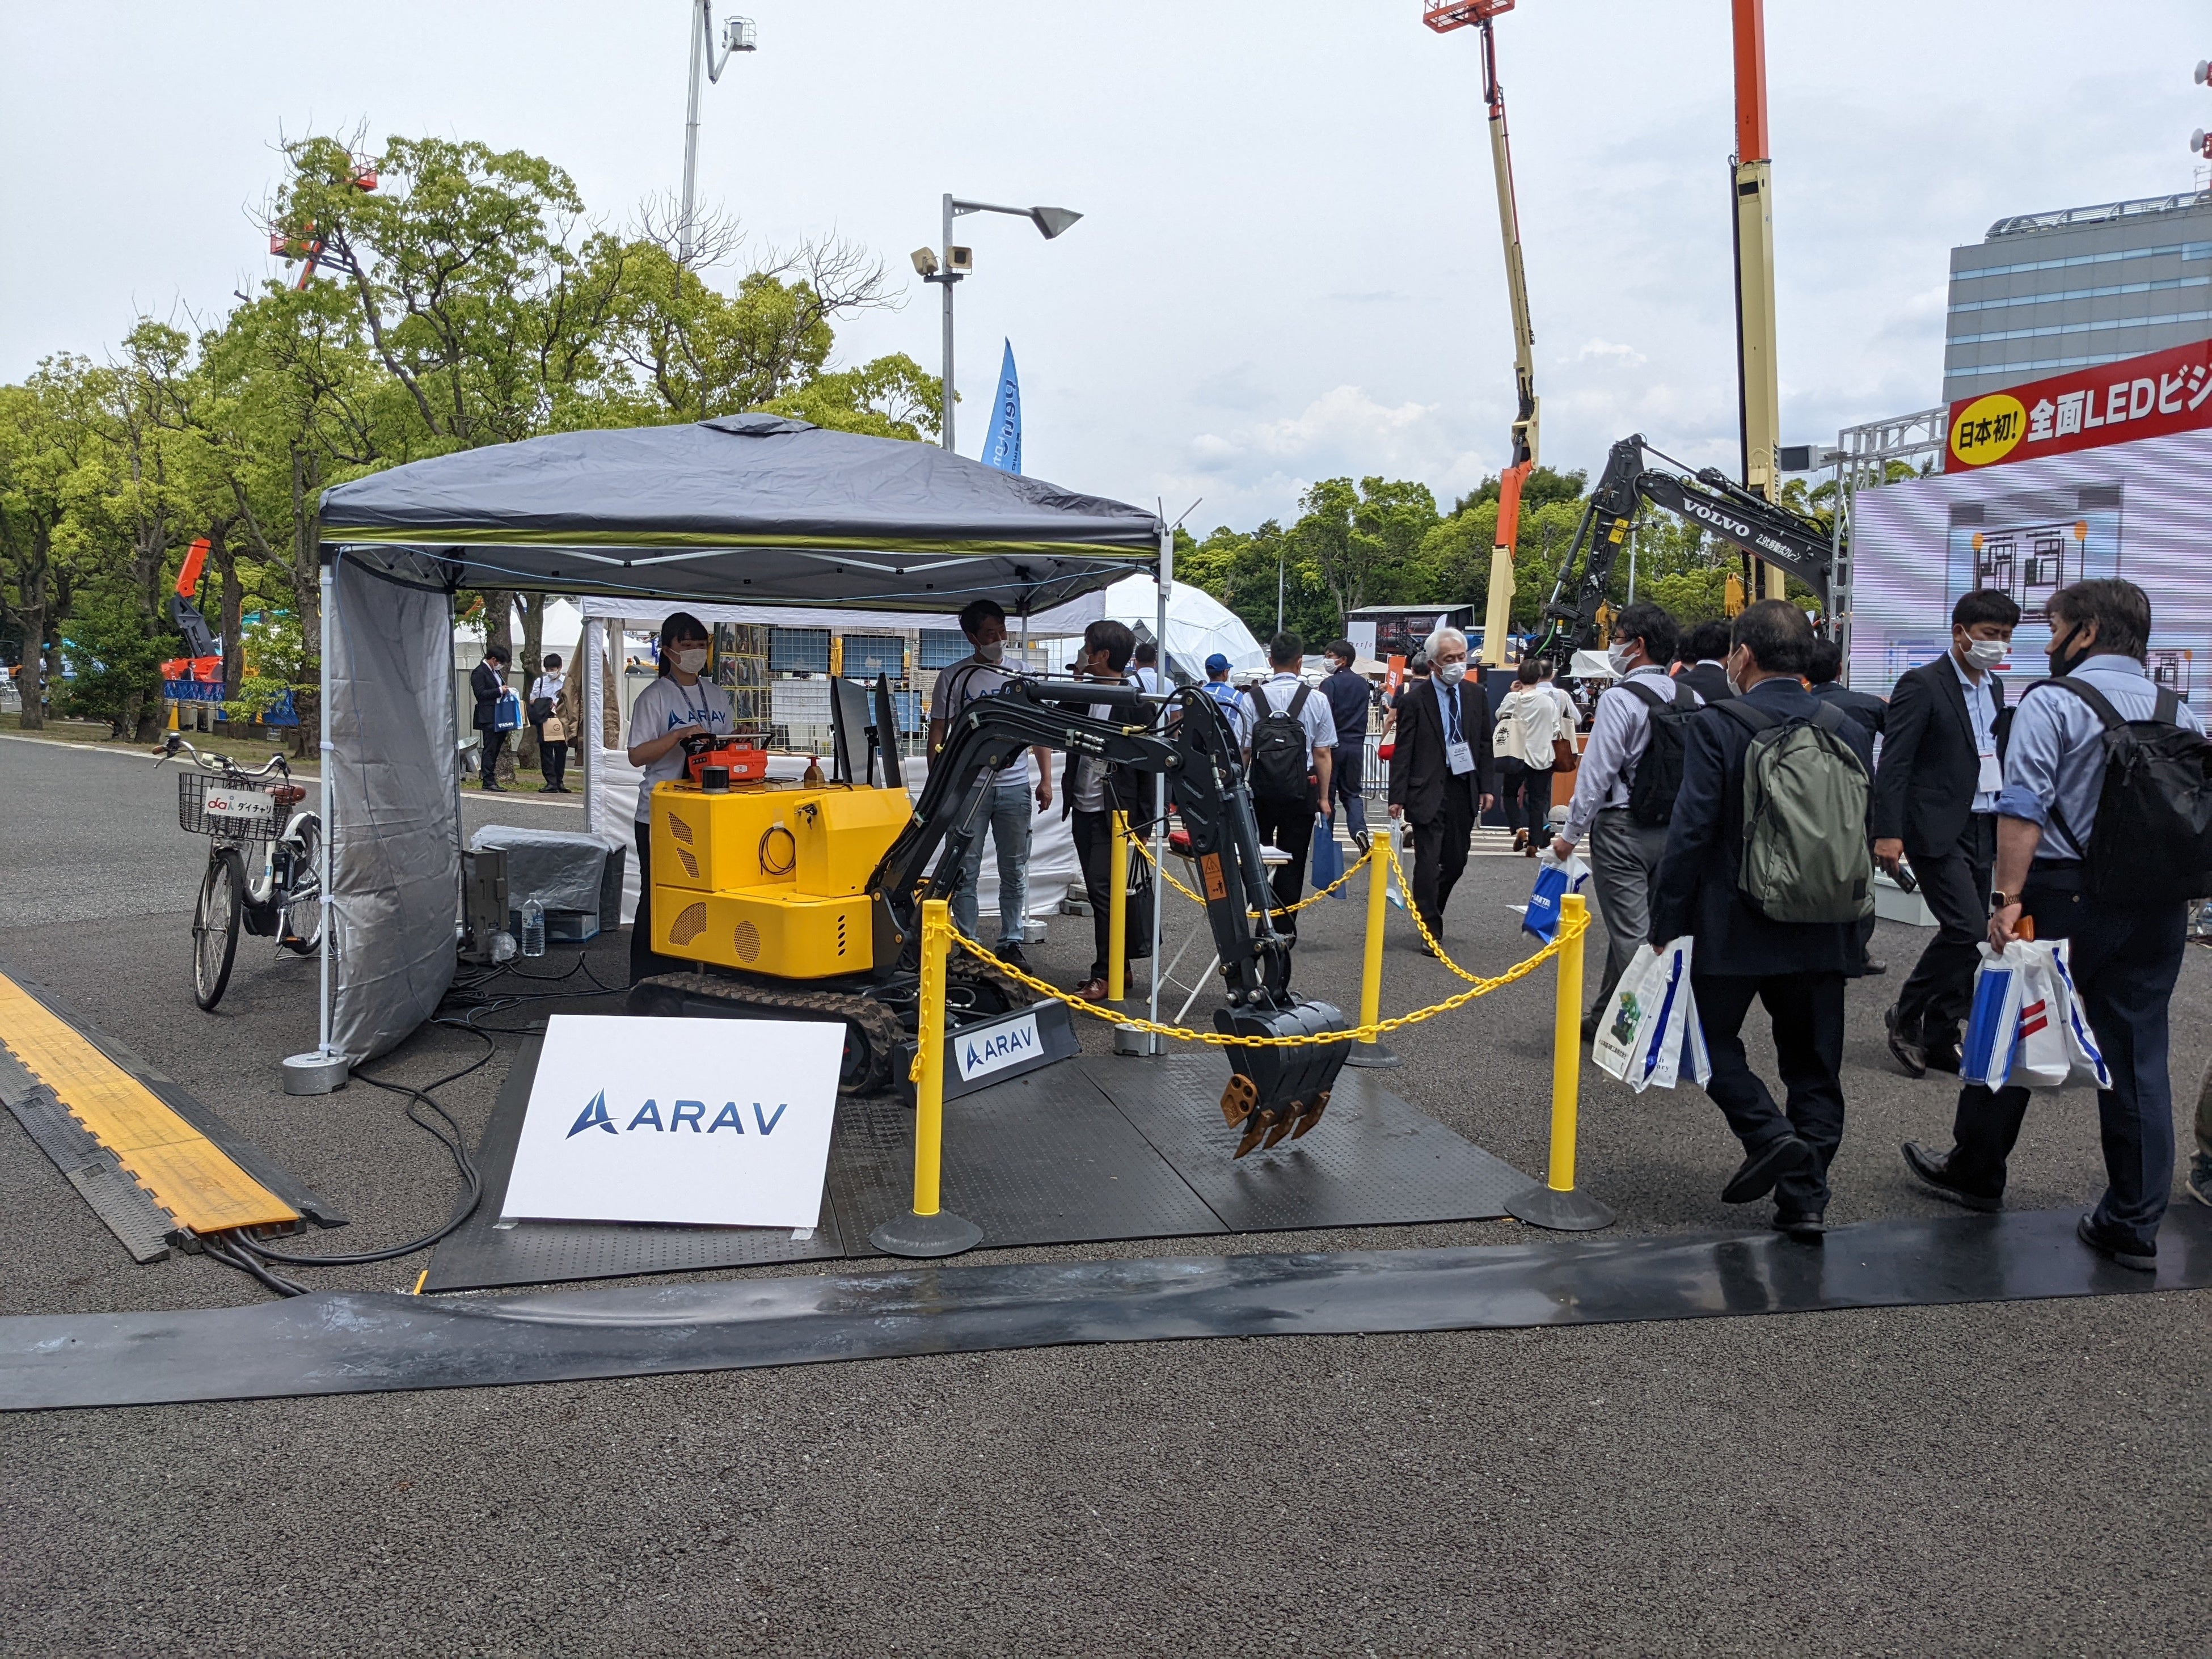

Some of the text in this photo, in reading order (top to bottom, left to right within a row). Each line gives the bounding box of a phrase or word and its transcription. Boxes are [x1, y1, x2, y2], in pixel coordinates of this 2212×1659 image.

[1958, 411, 2017, 450] 日本初!
[1683, 497, 1750, 537] VOLVO
[688, 709, 725, 724] ARAV
[238, 803, 272, 814] ダイチャリ
[985, 1025, 1031, 1061] ARAV
[626, 1099, 788, 1135] ARAV
